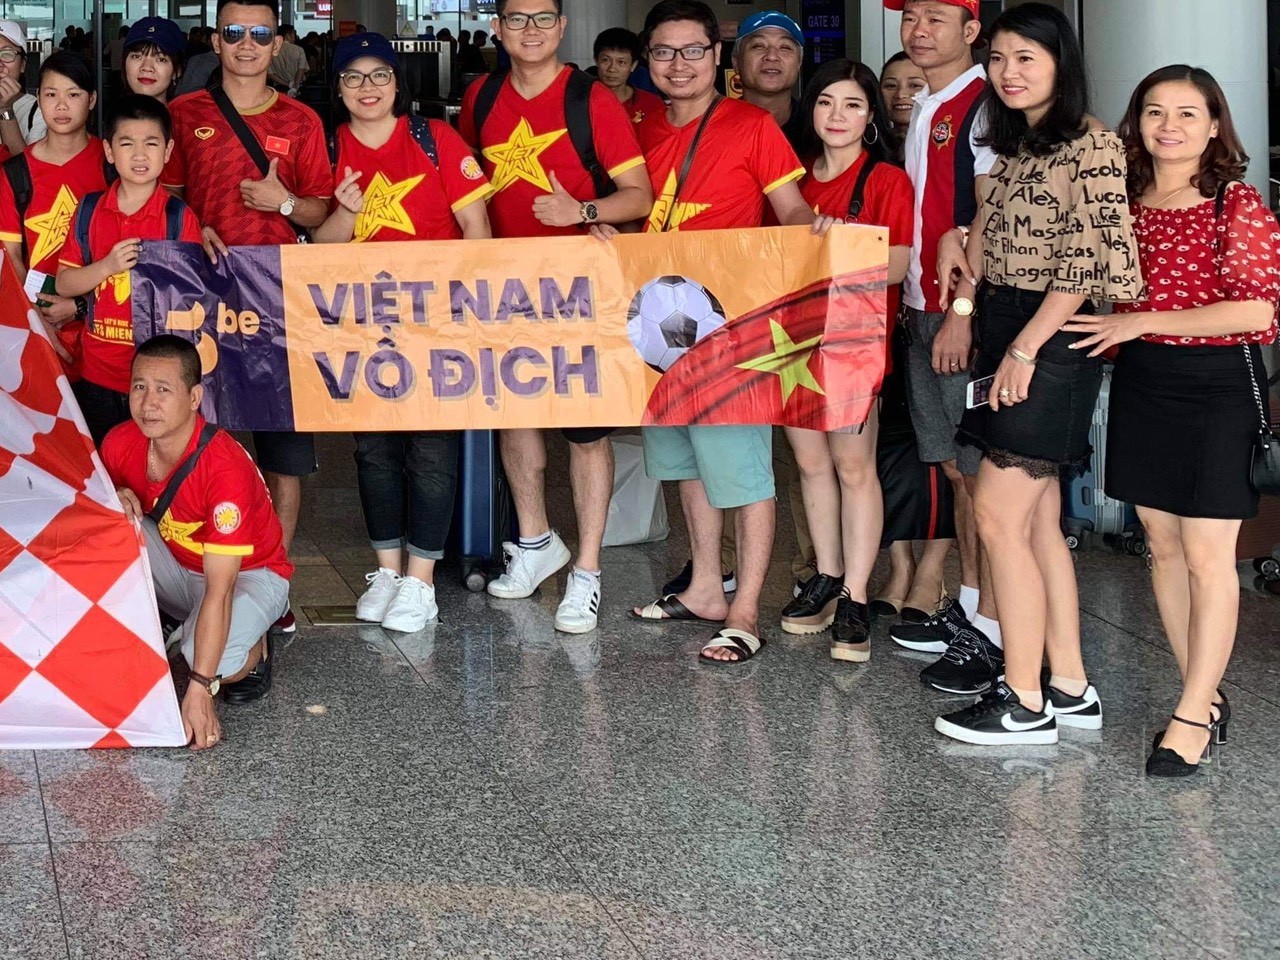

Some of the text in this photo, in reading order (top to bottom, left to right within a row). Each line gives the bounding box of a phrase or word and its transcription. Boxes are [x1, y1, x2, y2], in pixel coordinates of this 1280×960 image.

[808, 15, 840, 28] GATE 30
[1009, 185, 1060, 206] Alex
[216, 302, 261, 336] be
[307, 270, 595, 335] VIỆT NAM
[312, 336, 601, 408] VÔ ĐỊCH
